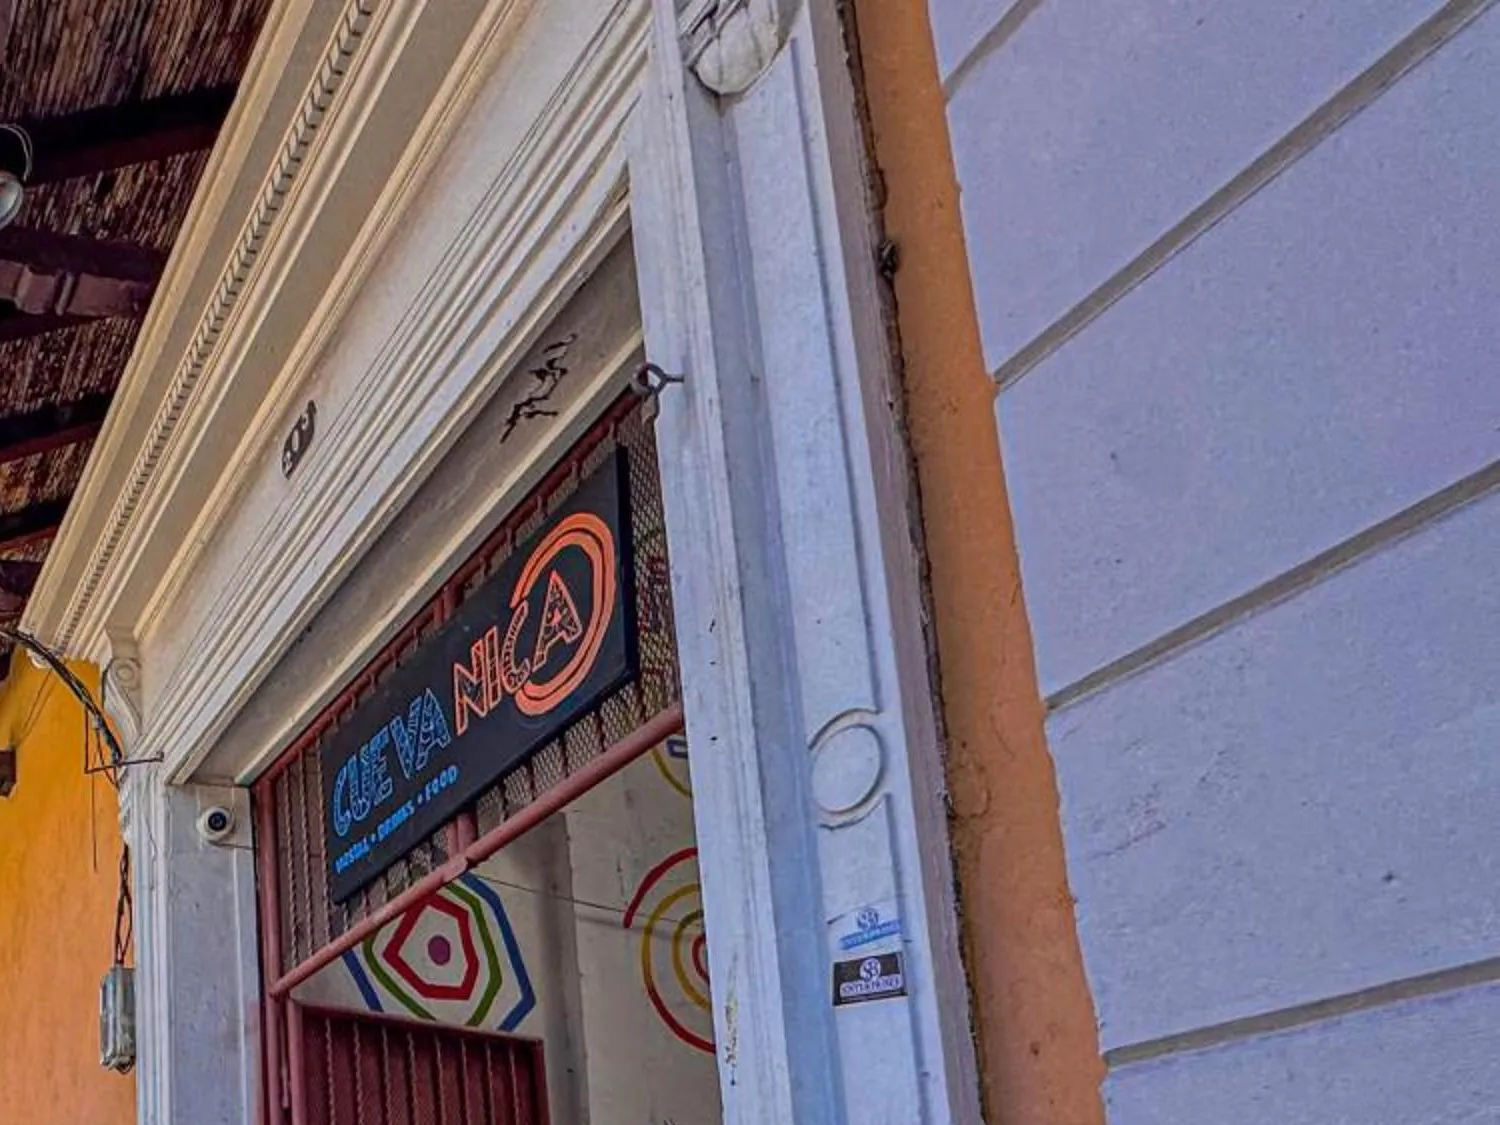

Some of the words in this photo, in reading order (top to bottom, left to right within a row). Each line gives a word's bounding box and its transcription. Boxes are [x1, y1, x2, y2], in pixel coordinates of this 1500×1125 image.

[334, 688, 452, 836] CUEVA
[453, 569, 584, 736] NICA
[425, 764, 459, 801] FOOD
